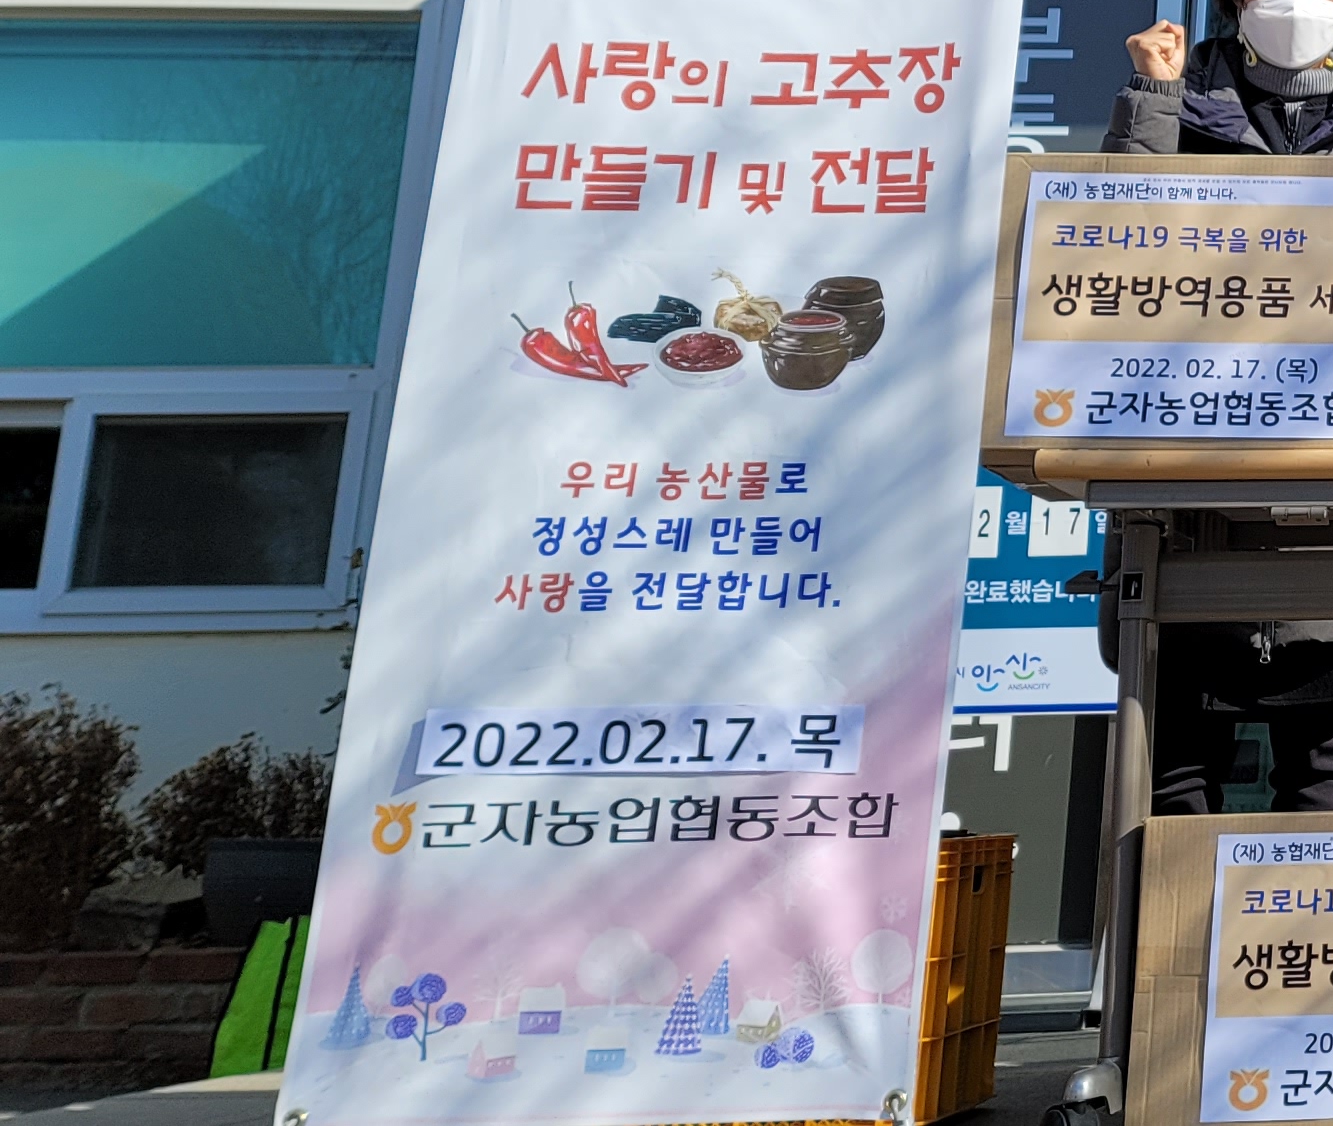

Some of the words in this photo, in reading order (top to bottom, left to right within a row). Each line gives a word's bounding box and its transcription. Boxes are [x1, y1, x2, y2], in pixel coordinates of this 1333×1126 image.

[520, 40, 729, 111] 사랑의
[750, 41, 962, 114] 고추장
[514, 143, 718, 212] 만들기
[736, 160, 787, 215] 및
[809, 146, 935, 214] 전달
[1044, 180, 1078, 199] (재)
[1083, 181, 1164, 201] 농협재단이
[1167, 186, 1193, 200] 함께
[1196, 186, 1238, 201] 합니다.
[1051, 224, 1169, 251] 코로나19
[1177, 226, 1251, 254] 극복을
[1258, 227, 1308, 255] 위한
[1040, 270, 1296, 319] 생활방역용품
[1110, 357, 1177, 380] 2022.
[1185, 357, 1222, 380] 02.
[1229, 358, 1266, 381] 17.
[1274, 357, 1319, 384] (목)
[559, 461, 639, 498] 우리
[654, 461, 810, 502] 농산물로
[530, 514, 690, 557] 정성스레
[708, 515, 824, 556] 만들어
[493, 571, 614, 613] 사랑을
[631, 570, 842, 612] 전달합니다.
[432, 717, 769, 768] 2022.02.17.
[790, 714, 842, 768] 목
[420, 791, 900, 848] 군자농업협동조합
[1232, 843, 1265, 864] (재)
